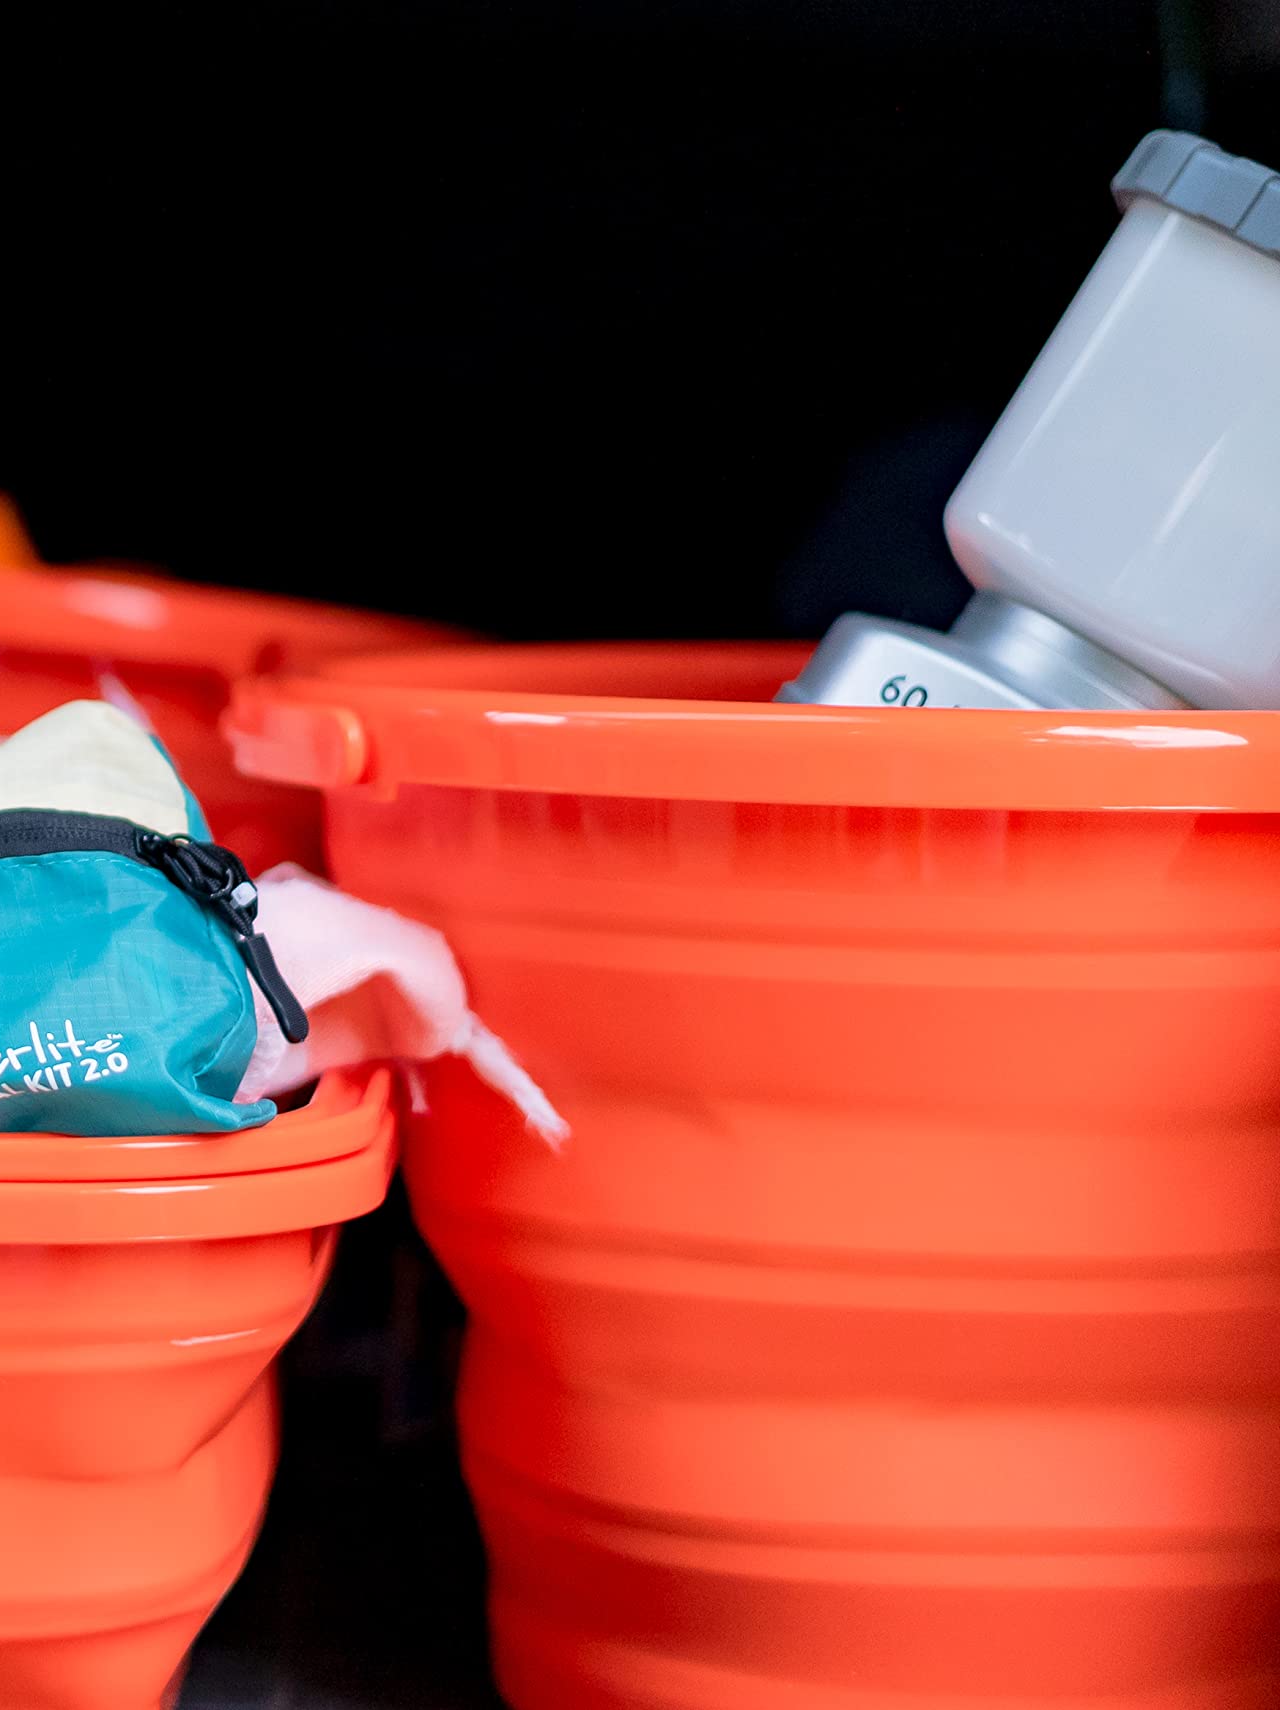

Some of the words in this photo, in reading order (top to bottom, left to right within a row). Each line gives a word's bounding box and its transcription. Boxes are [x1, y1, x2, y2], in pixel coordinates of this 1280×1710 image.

[880, 675, 928, 707] 60
[23, 1062, 73, 1093] KIT
[79, 1052, 129, 1083] 2.0
